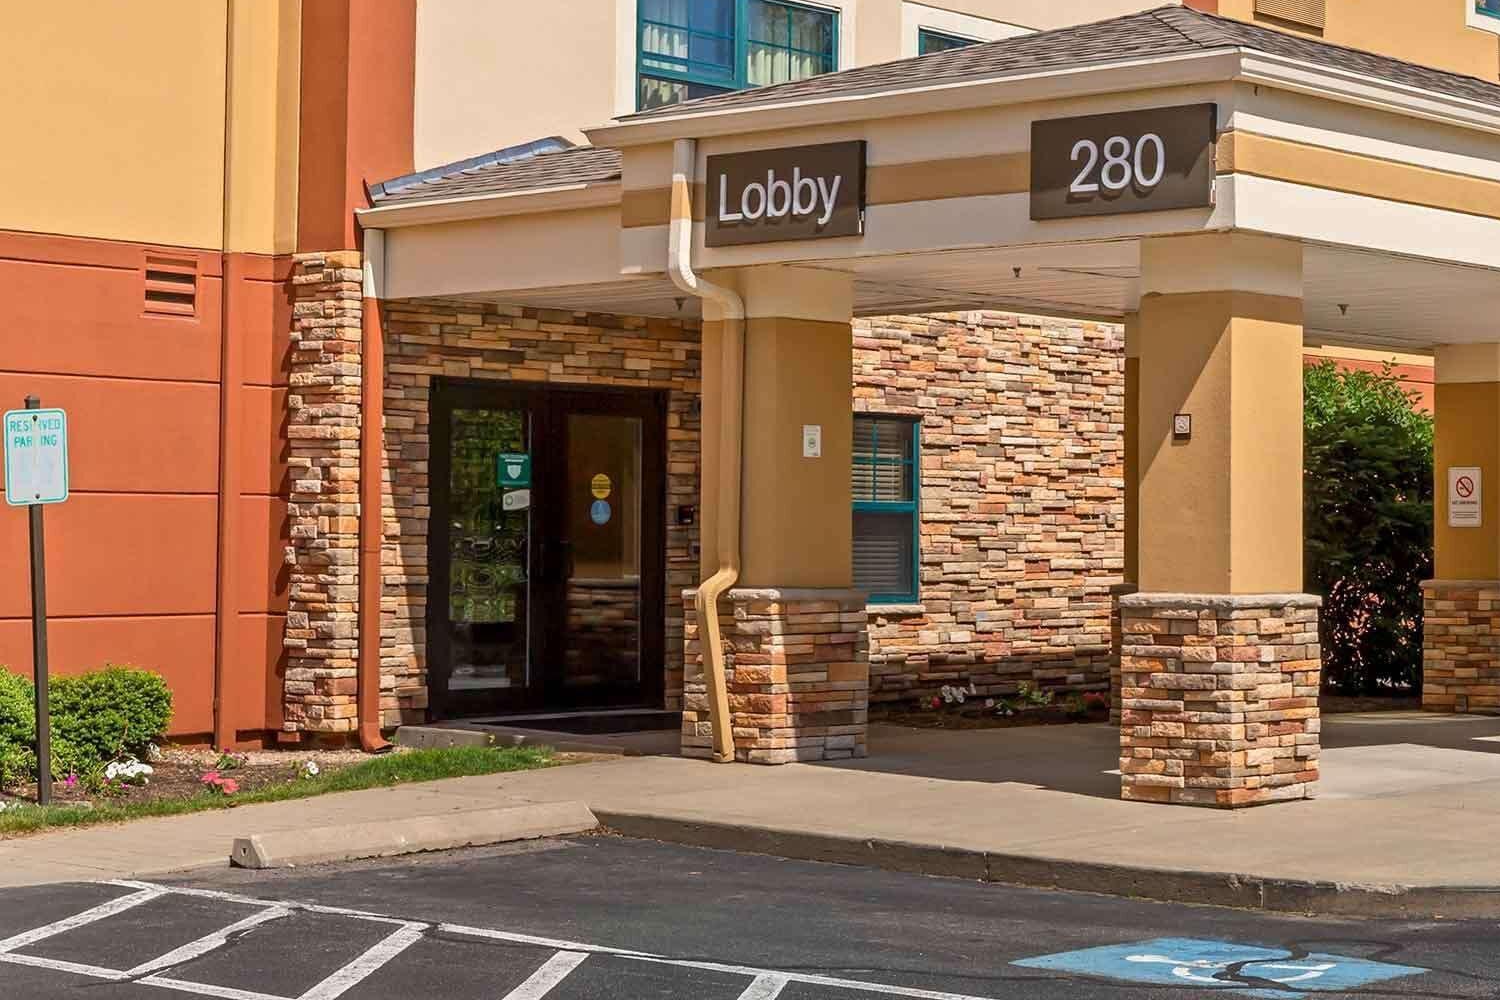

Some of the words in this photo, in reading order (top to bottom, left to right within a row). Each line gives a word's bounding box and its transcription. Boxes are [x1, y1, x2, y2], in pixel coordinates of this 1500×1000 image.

[1070, 133, 1165, 192] 280
[719, 167, 841, 224] Lobby
[10, 418, 61, 432] RESVED
[14, 434, 57, 447] PARING
